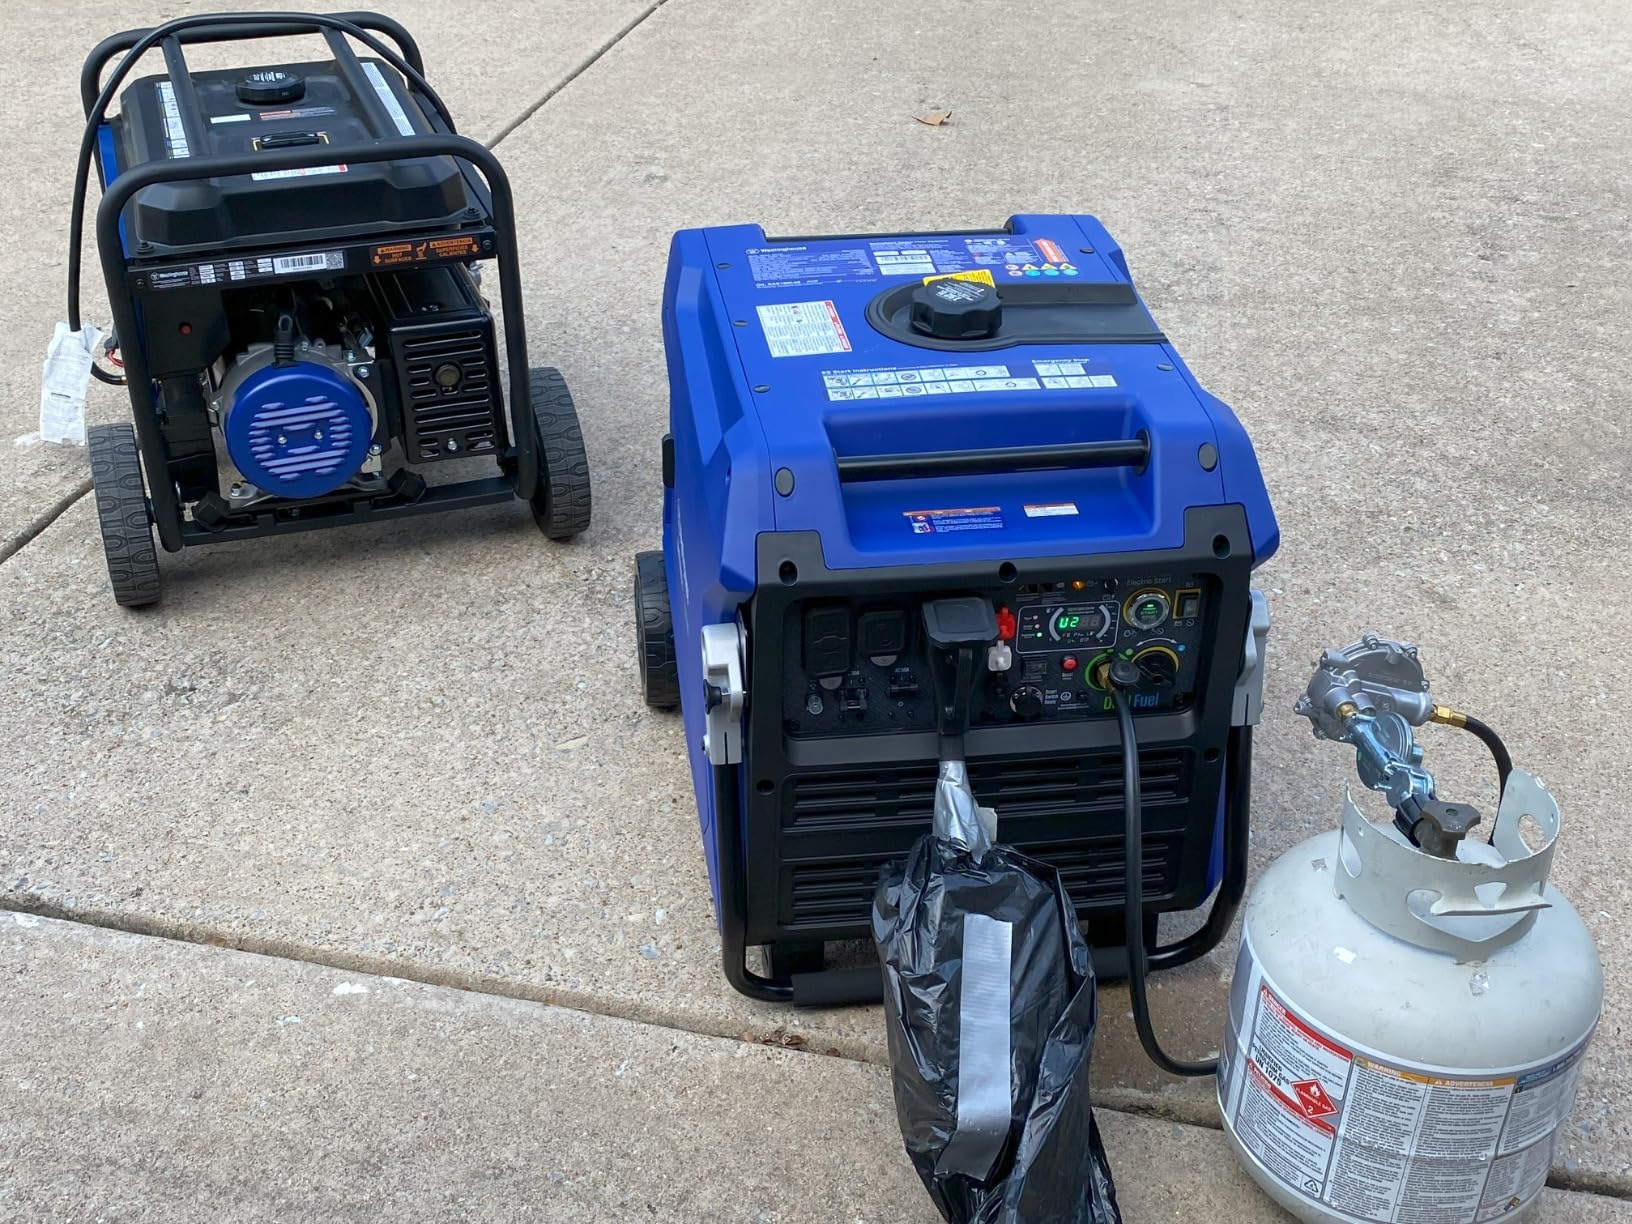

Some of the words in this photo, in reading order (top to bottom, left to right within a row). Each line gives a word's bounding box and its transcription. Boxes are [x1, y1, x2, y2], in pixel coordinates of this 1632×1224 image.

[1126, 576, 1153, 585] Electric
[1153, 574, 1173, 584] Start
[1255, 1054, 1264, 1068] UN
[1264, 1066, 1282, 1086] 1075
[1367, 1061, 1402, 1077] WARNING
[1307, 1105, 1314, 1114] 2
